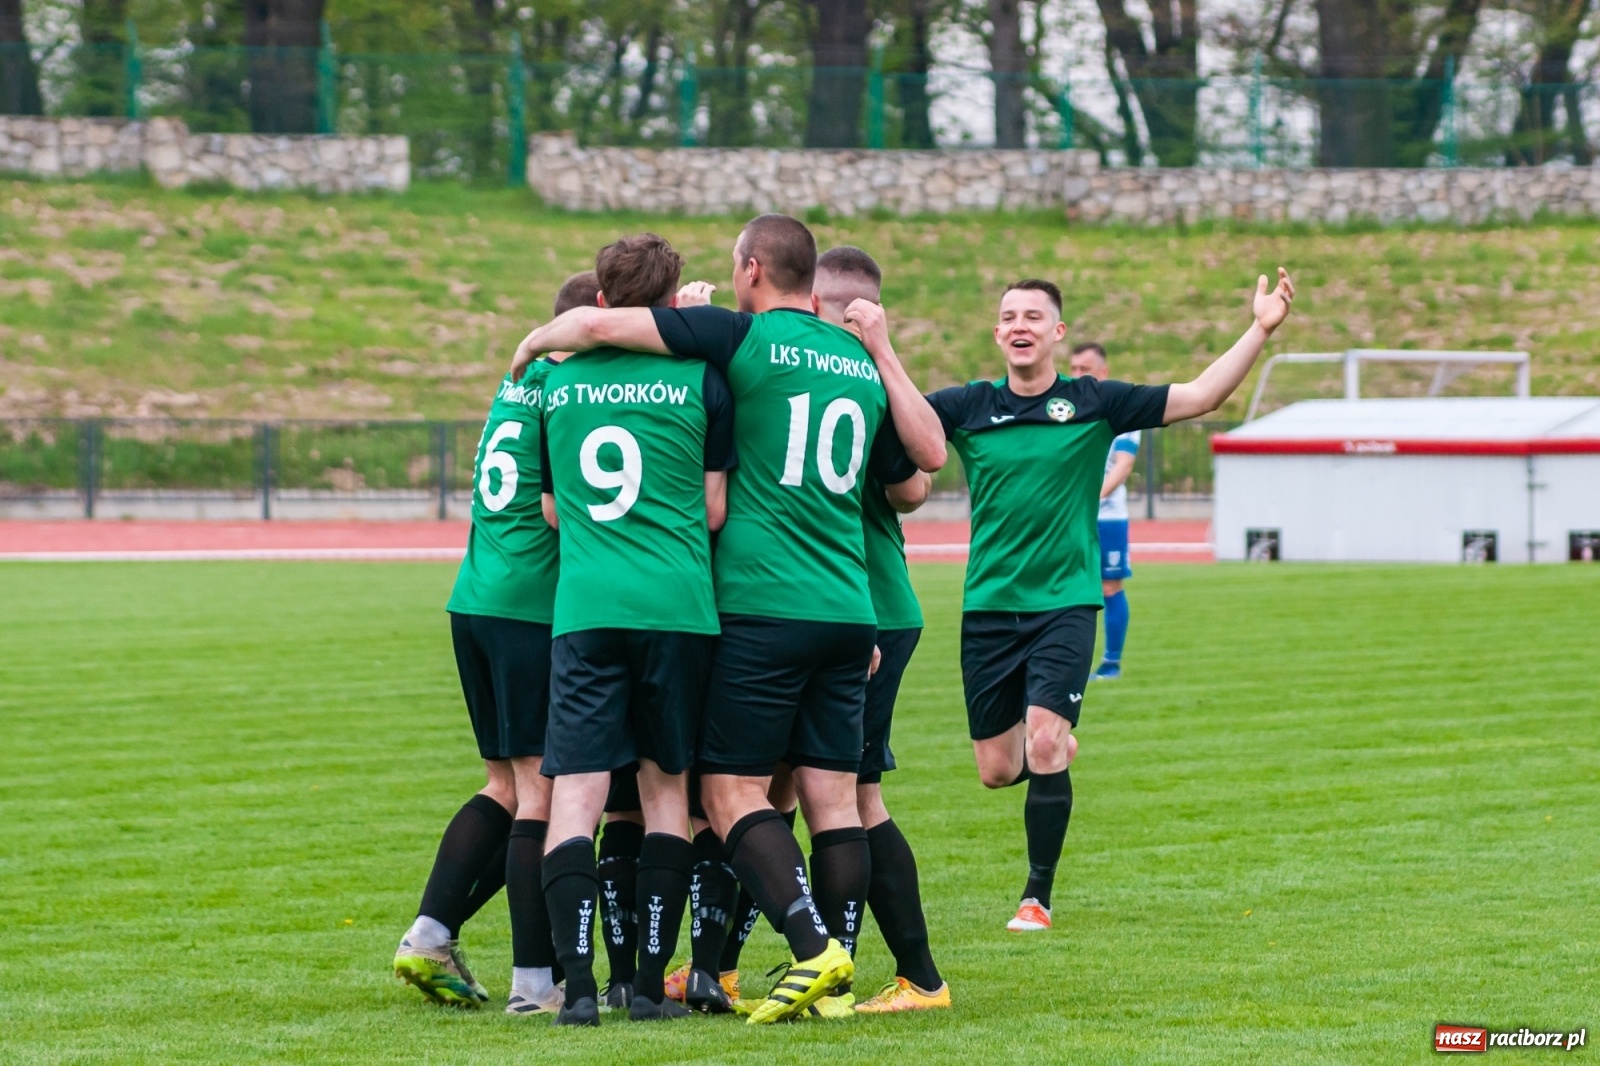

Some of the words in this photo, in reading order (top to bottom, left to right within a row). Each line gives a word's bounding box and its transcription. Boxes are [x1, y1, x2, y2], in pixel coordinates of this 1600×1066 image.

[770, 344, 800, 366] LKS
[574, 380, 688, 404] TWORKÓW
[580, 425, 642, 521] 9
[779, 392, 866, 494] 10
